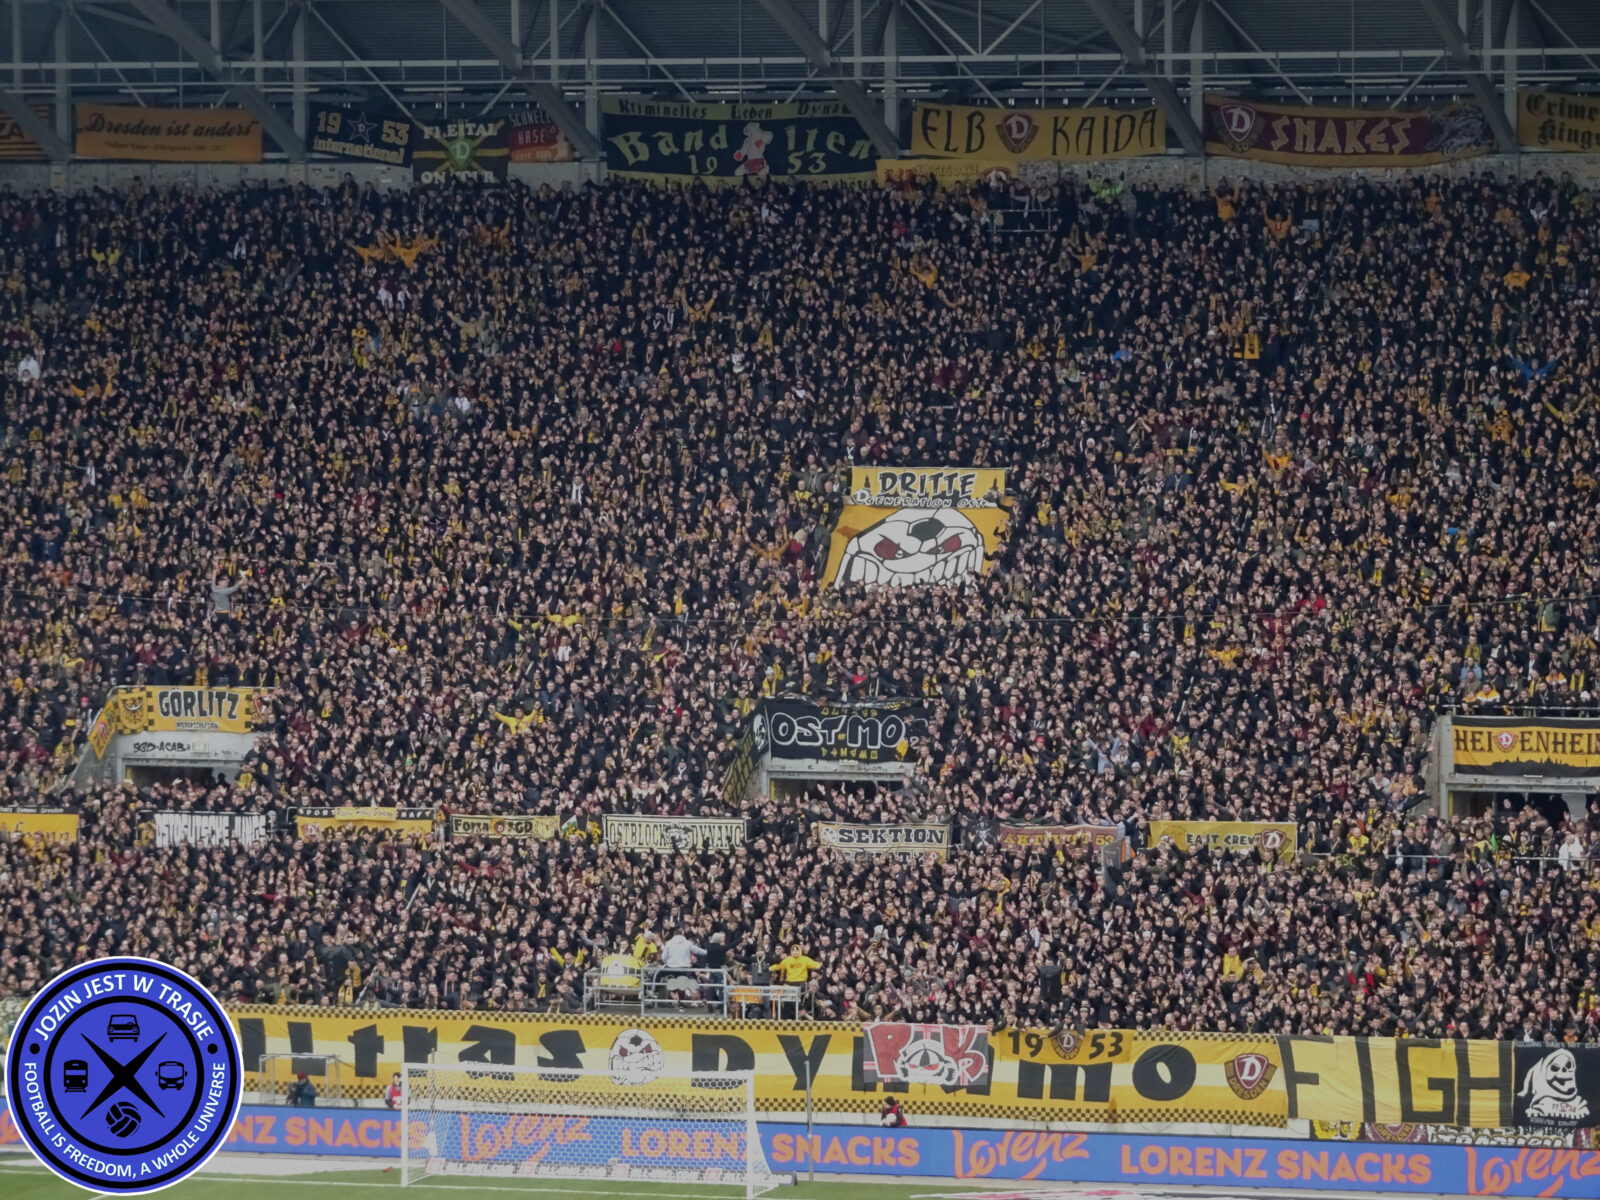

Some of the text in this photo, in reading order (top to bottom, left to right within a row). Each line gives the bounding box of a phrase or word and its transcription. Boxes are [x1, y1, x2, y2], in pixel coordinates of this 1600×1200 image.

[618, 100, 707, 118] Kriminelles
[730, 104, 773, 120] Leben
[166, 120, 189, 136] ist
[317, 111, 342, 134] 19
[381, 120, 411, 146] 53
[920, 107, 986, 154] ELB
[1051, 107, 1157, 156] KAIDA
[1269, 115, 1412, 155] SNAKES
[687, 150, 827, 175] 19 53
[421, 170, 447, 185] ON
[879, 471, 977, 498] DRITTE
[867, 494, 952, 508] GENERATION
[157, 687, 241, 720] GÖRLITZ
[609, 822, 666, 847] OSTBLOCK
[838, 828, 945, 844] SEKTION
[1007, 1031, 1043, 1058] 19
[1088, 1031, 1124, 1059] 53
[1227, 1076, 1271, 1100] DRESDEN
[284, 1115, 430, 1149] SNACKS
[459, 1113, 594, 1166] Lorenz
[771, 1133, 921, 1168] SNACKS
[952, 1130, 1090, 1180] Lorenz
[1121, 1144, 1268, 1179] LORENZ
[1277, 1149, 1432, 1184] SNACKS
